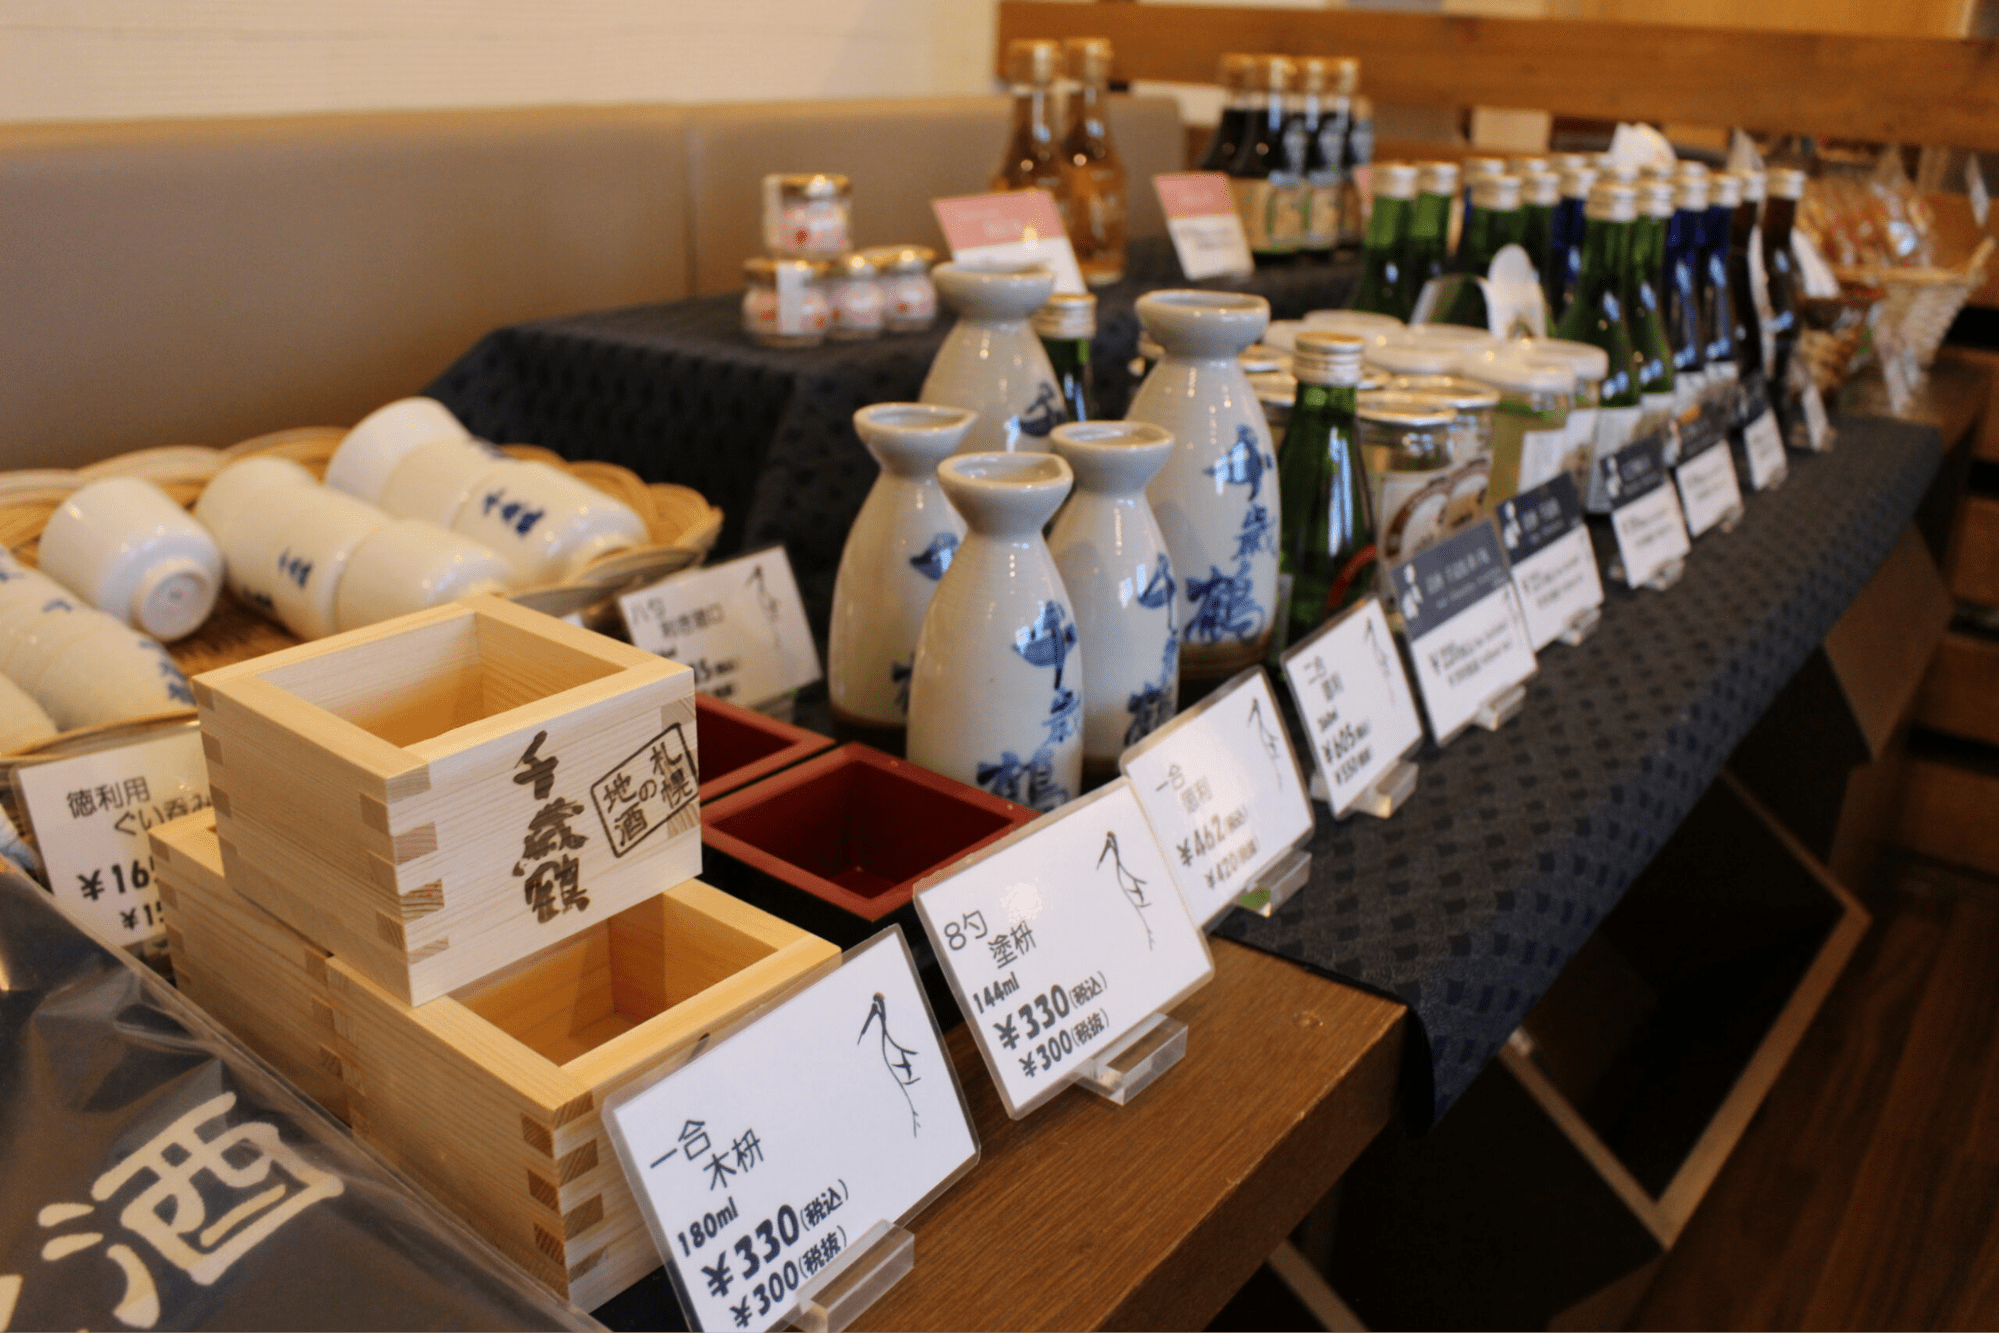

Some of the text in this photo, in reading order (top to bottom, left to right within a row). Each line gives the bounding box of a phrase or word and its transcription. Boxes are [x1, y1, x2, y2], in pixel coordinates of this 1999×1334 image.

[67, 776, 150, 819] 徳利用
[1155, 763, 1185, 791] 一合
[77, 856, 157, 901] ¥16
[120, 901, 165, 930] ¥1
[944, 909, 988, 950] 8勺
[988, 920, 1036, 969] 塗枡
[973, 972, 1020, 1014] 144ml
[649, 1118, 712, 1169] 一合
[703, 1128, 765, 1191] 木枡
[37, 1091, 345, 1329] 酒
[678, 1196, 739, 1257] 180ml
